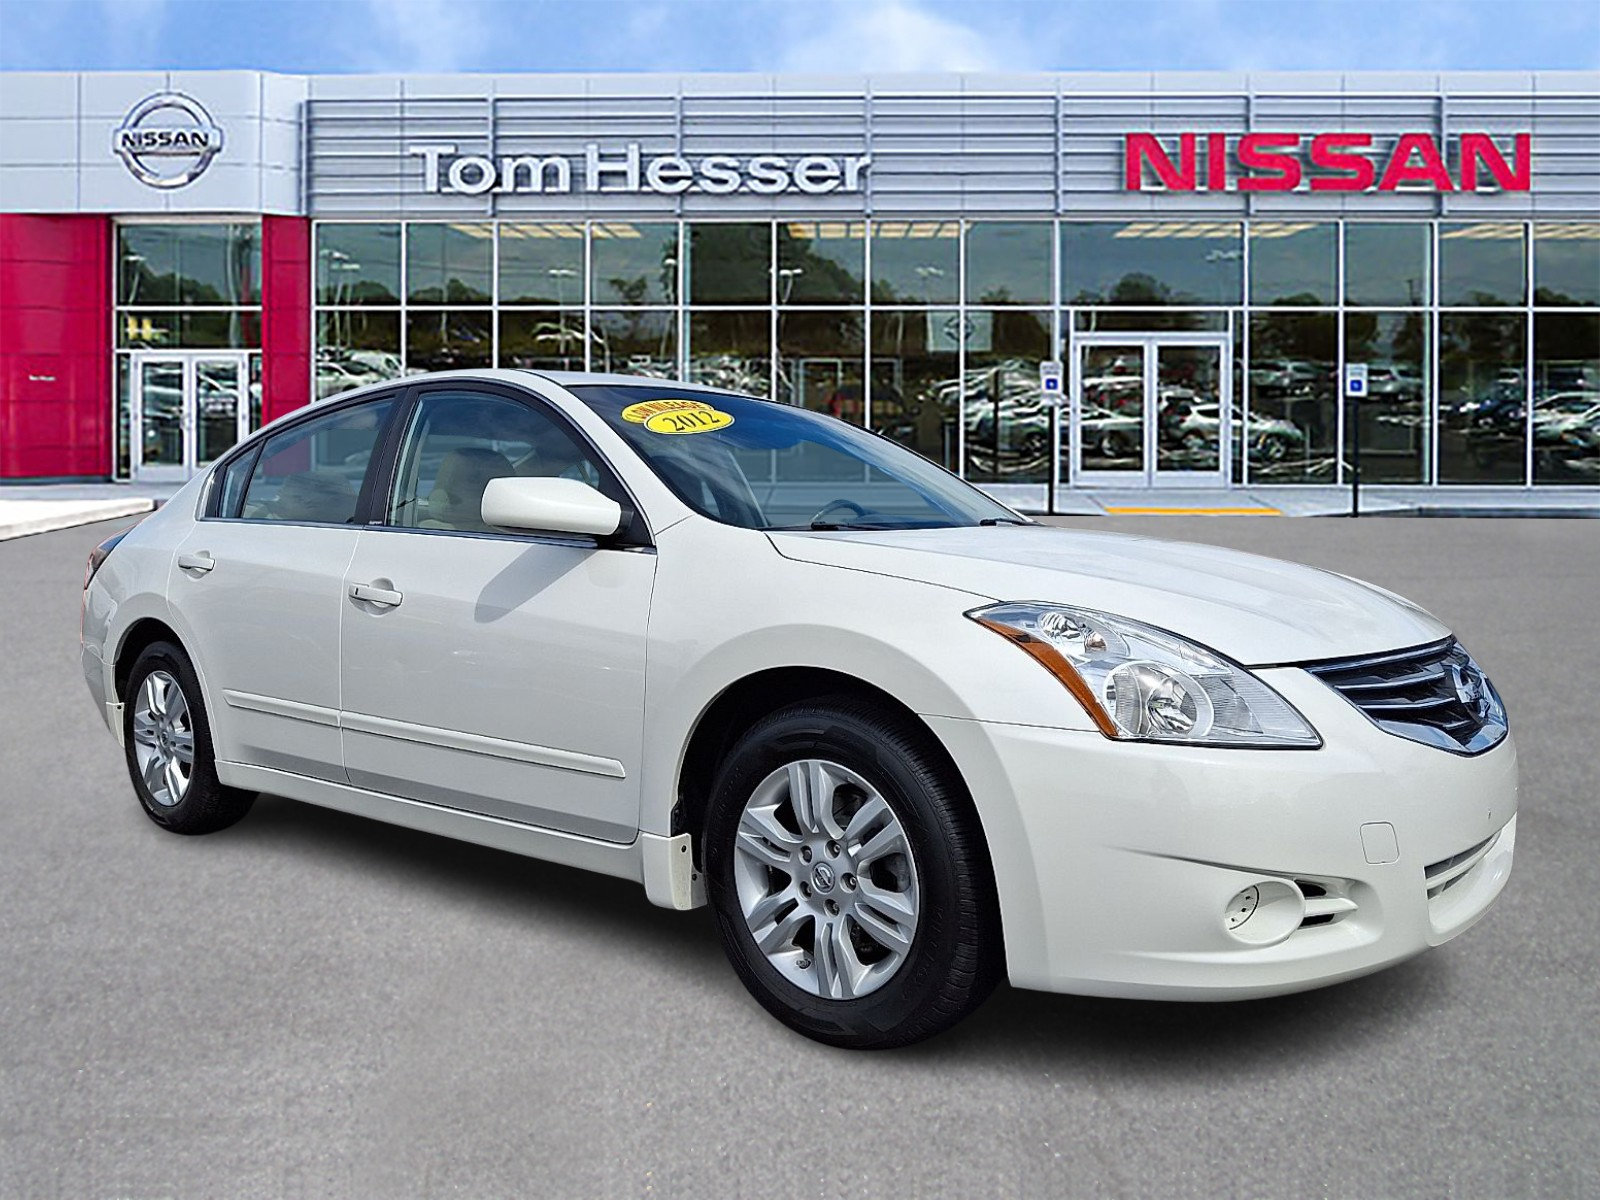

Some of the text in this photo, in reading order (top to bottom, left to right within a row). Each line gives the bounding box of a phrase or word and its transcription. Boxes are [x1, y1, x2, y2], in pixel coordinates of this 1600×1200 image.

[122, 131, 209, 148] NISSAN
[409, 143, 871, 195] Tom Hesser
[1125, 132, 1531, 191] NISSAN
[662, 410, 721, 432] 2012
